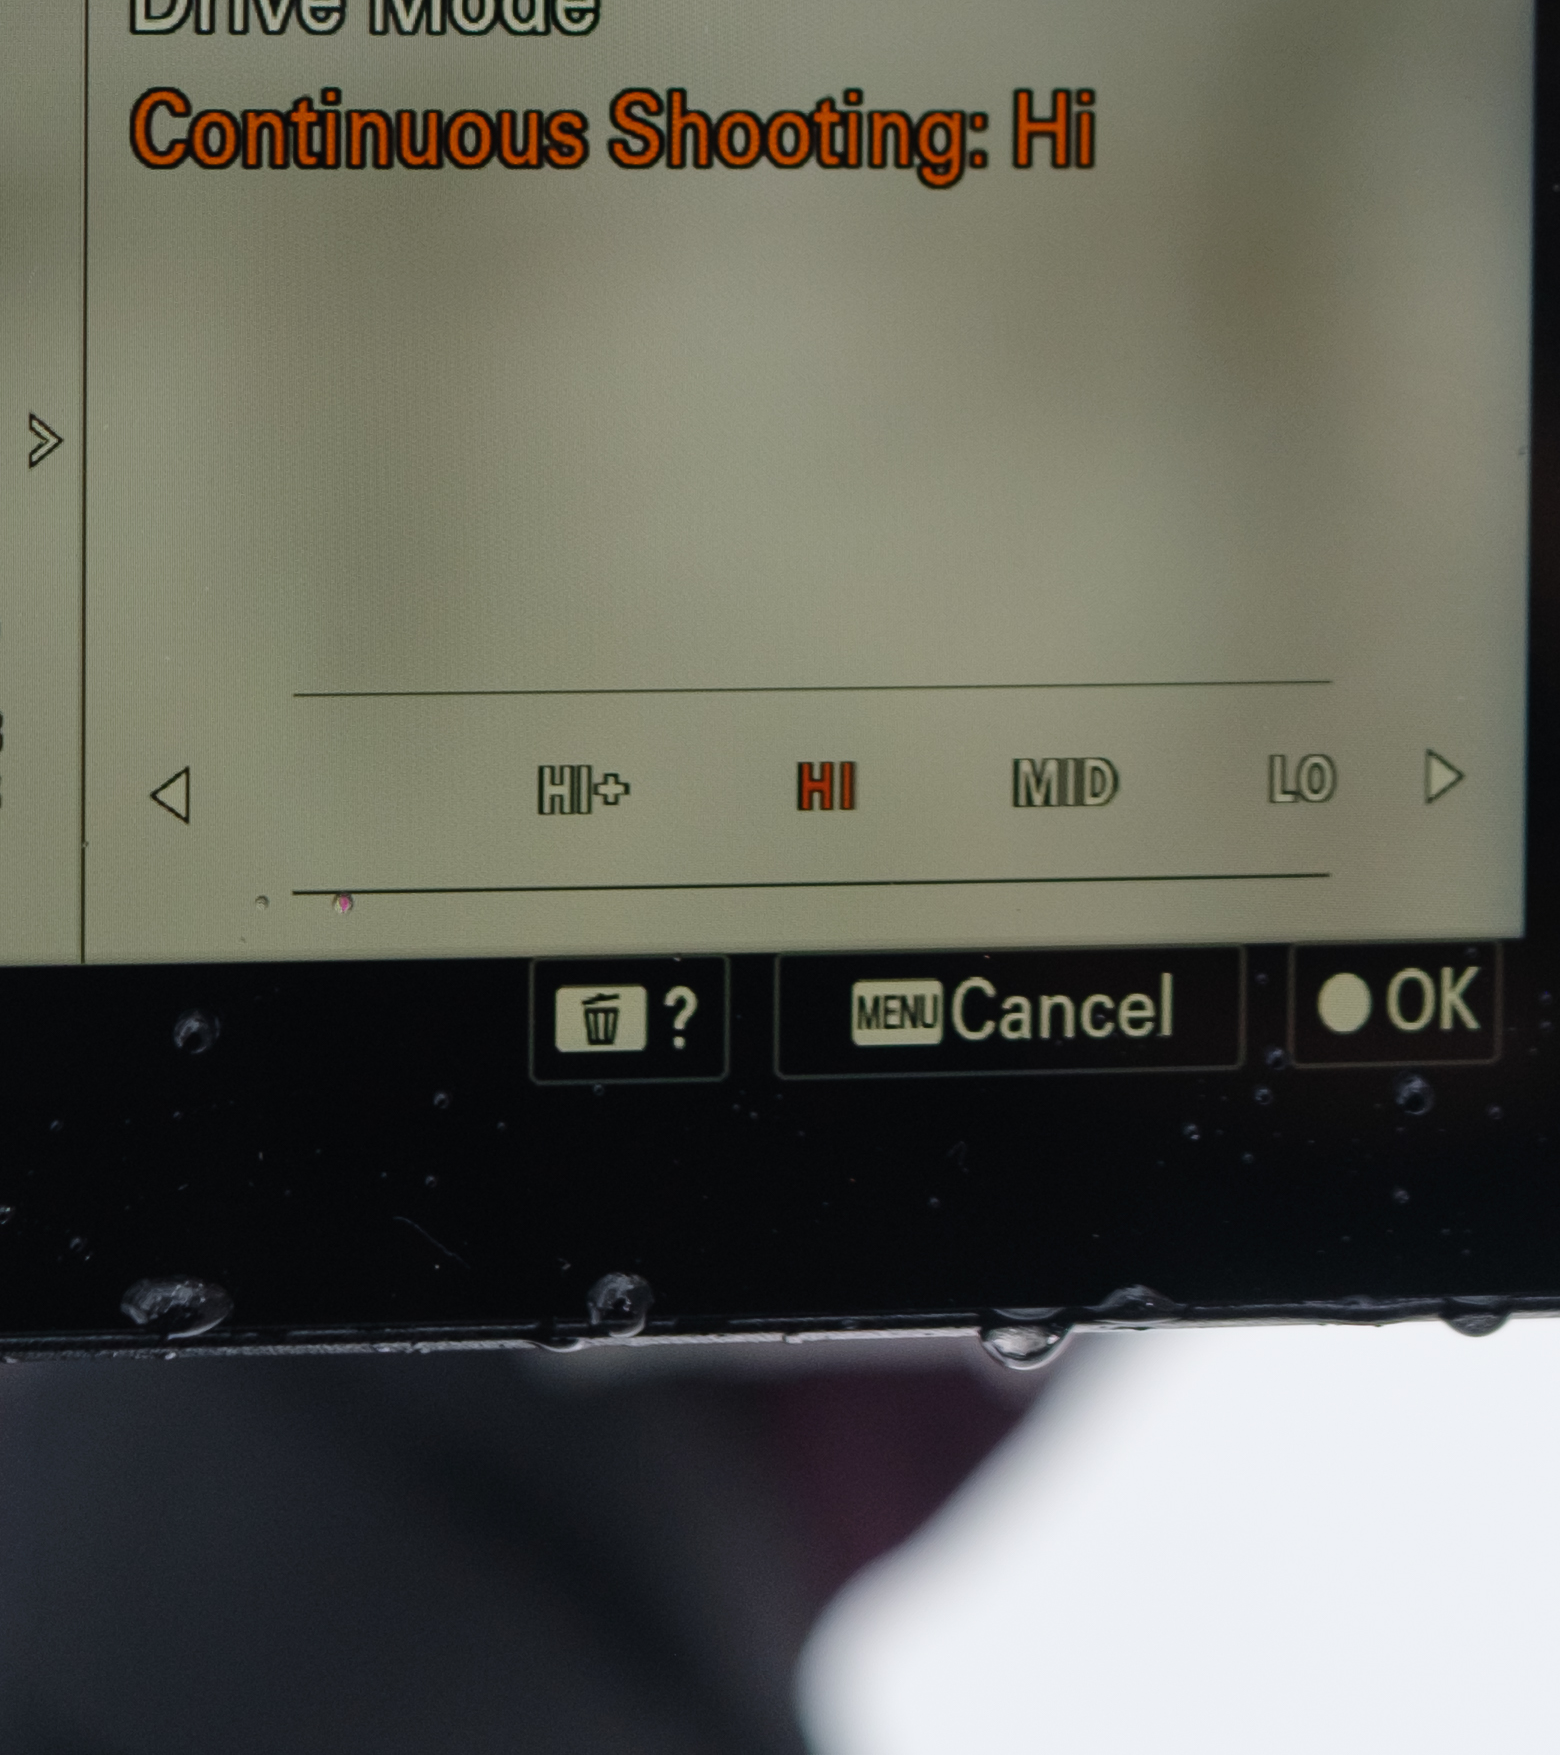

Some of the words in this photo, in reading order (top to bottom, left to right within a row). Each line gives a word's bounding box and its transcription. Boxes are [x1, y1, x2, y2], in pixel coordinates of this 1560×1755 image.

[130, 87, 590, 169] Continuous
[608, 87, 989, 189] Shooting:
[1011, 87, 1097, 170] Hi
[537, 763, 631, 815] HI+
[796, 759, 858, 811] HI
[1012, 755, 1121, 809] MID
[1266, 753, 1338, 805] LO
[662, 986, 700, 1050] ?
[855, 991, 938, 1033] MENU
[950, 972, 1175, 1042] Cancel
[1385, 965, 1482, 1034] OK
